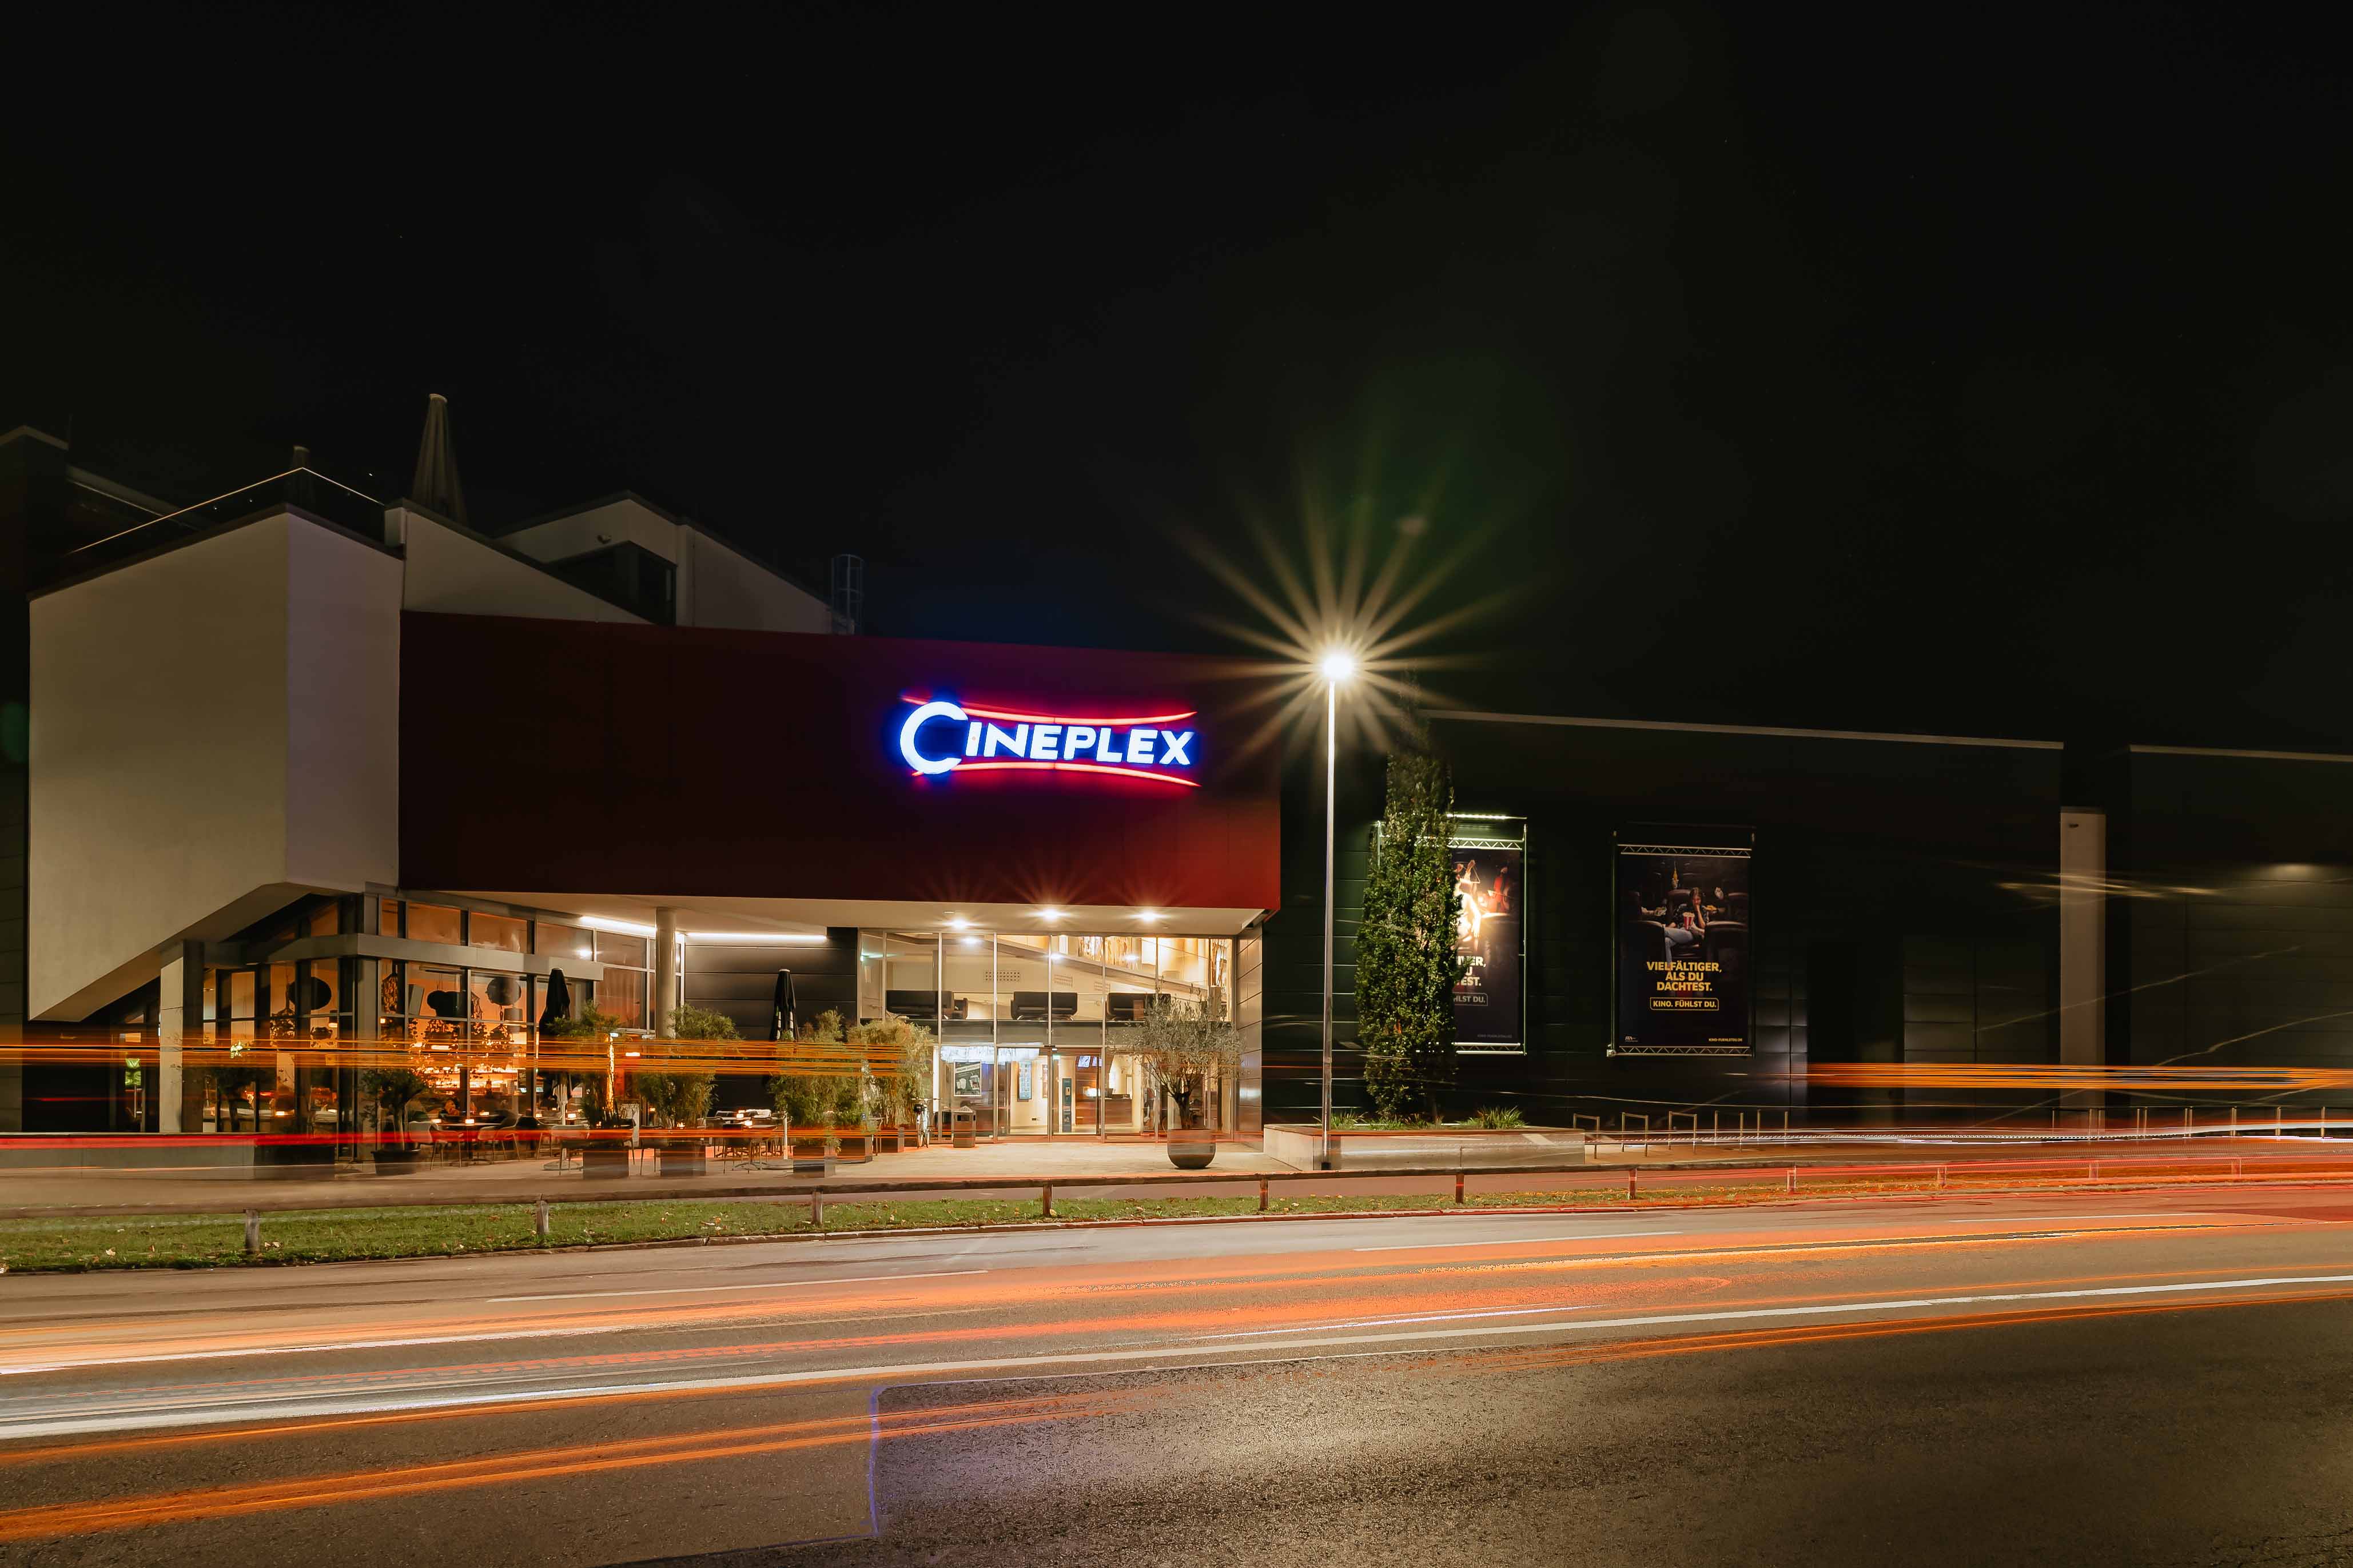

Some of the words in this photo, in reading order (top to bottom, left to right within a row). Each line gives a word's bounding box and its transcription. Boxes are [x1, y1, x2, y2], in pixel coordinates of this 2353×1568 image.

[899, 701, 1195, 775] CINEPLEX
[1646, 961, 1722, 973] VIELFÄLTIGER,
[1665, 972, 1685, 981] ALS
[1688, 972, 1703, 981] DU
[1657, 982, 1713, 991] DACHTEST.
